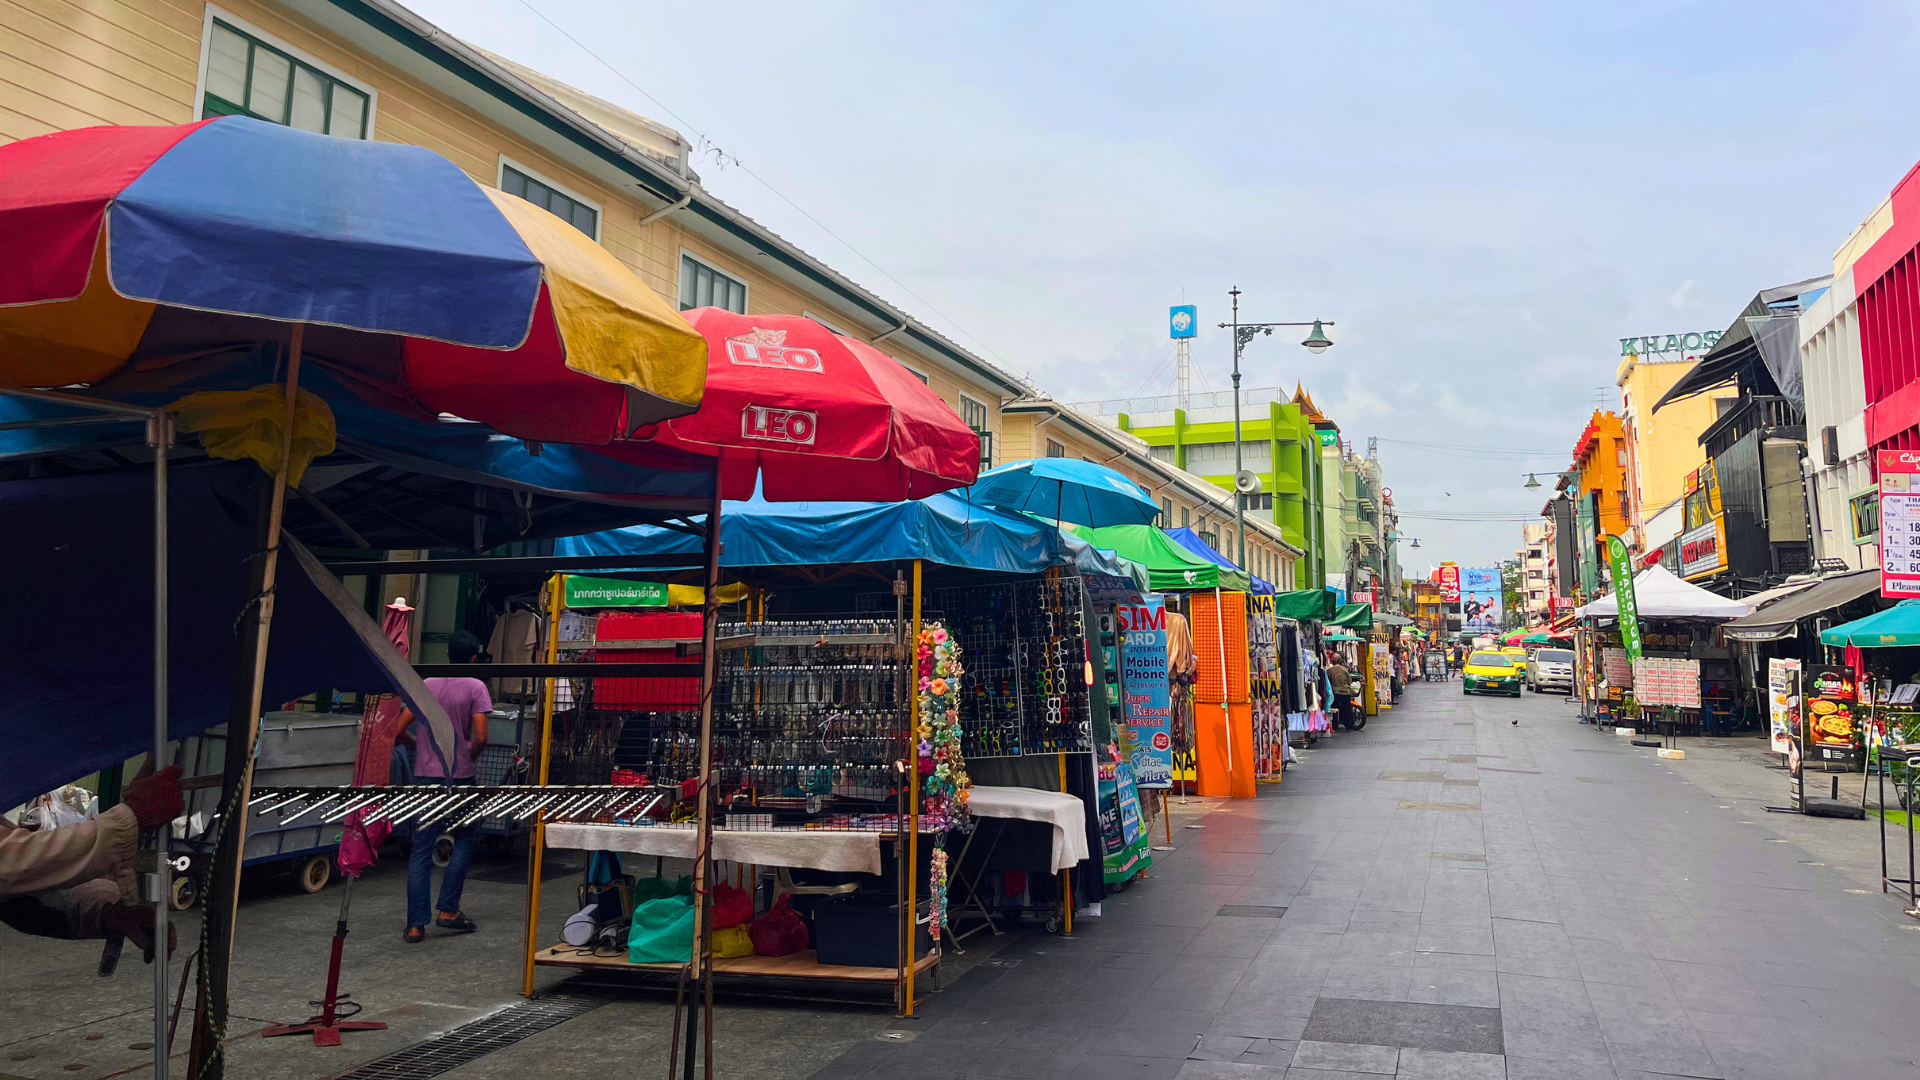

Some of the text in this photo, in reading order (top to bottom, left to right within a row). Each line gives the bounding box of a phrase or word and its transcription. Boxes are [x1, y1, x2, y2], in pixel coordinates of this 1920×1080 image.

[730, 342, 820, 371] LEO
[744, 407, 815, 443] LEO
[1909, 522, 1920, 532] 18
[1909, 536, 1920, 546] 30
[1909, 549, 1920, 560] 45
[1887, 562, 1894, 572] 2
[1910, 562, 1920, 573] 60
[1891, 582, 1920, 591] Pleasu
[1119, 606, 1166, 631] SIM
[1123, 633, 1156, 645] ARD
[1126, 656, 1165, 667] Mobile
[1126, 668, 1165, 679] Phone
[1250, 680, 1279, 700] NNA
[1140, 755, 1162, 767] dtac
